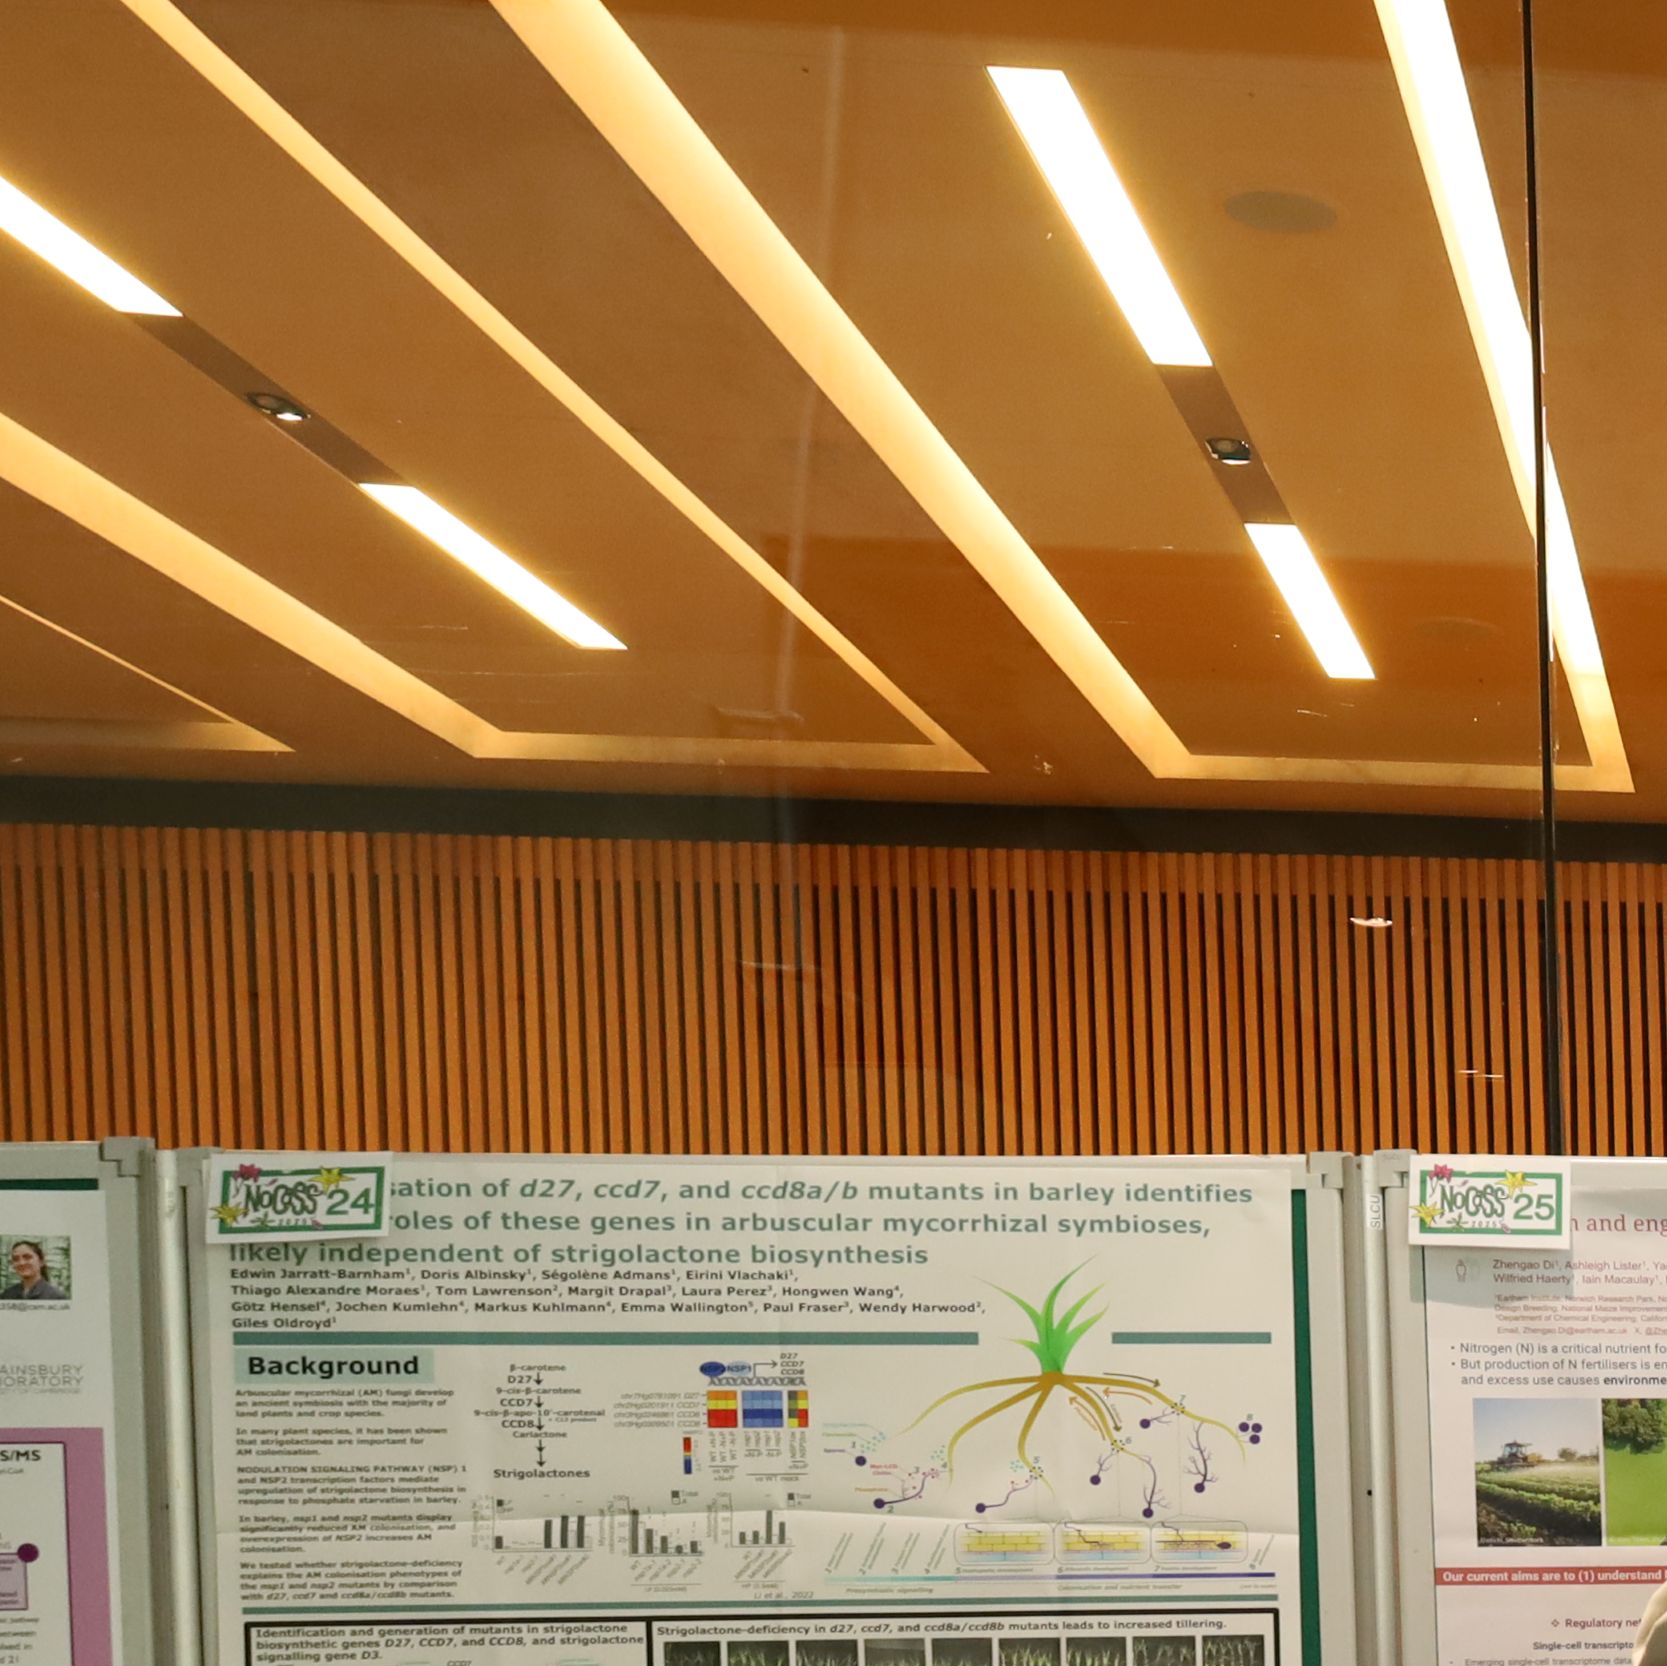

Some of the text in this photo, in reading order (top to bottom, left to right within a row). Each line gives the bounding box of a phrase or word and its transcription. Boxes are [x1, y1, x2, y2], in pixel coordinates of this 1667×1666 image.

[326, 1187, 375, 1216] 24
[481, 1177, 511, 1199] of
[519, 1177, 583, 1203] d27,
[593, 1178, 668, 1204] ccd7,
[678, 1179, 731, 1200] and
[740, 1179, 859, 1204] ccd8a/b
[868, 1181, 985, 1202] mutants
[994, 1181, 1019, 1202] in
[1028, 1181, 1115, 1208] barley
[1124, 1182, 1253, 1204] identifies
[1513, 1193, 1555, 1221] 25
[389, 1209, 1210, 1239] oles of these genes in arbuscular mycorrhizal symbioses,
[1586, 1212, 1627, 1233] and
[228, 1240, 929, 1270] likely independent of strigolactone biosynthesis
[1459, 1341, 1513, 1357] Nitrogen
[1515, 1342, 1535, 1357] (N)
[1537, 1344, 1549, 1355] is
[1550, 1344, 1559, 1355] a
[1560, 1342, 1603, 1355] critical
[1604, 1343, 1651, 1355] nutrient
[248, 1354, 419, 1381] Background
[1461, 1374, 1484, 1386] and
[1486, 1375, 1530, 1386] excess
[1532, 1375, 1555, 1386] use
[1556, 1375, 1600, 1387] causes
[656, 1618, 1226, 1639] Strigolactone-deficiency in d27, ccd7, and ccd8a/ccd8b mutants leads to increased tillering.
